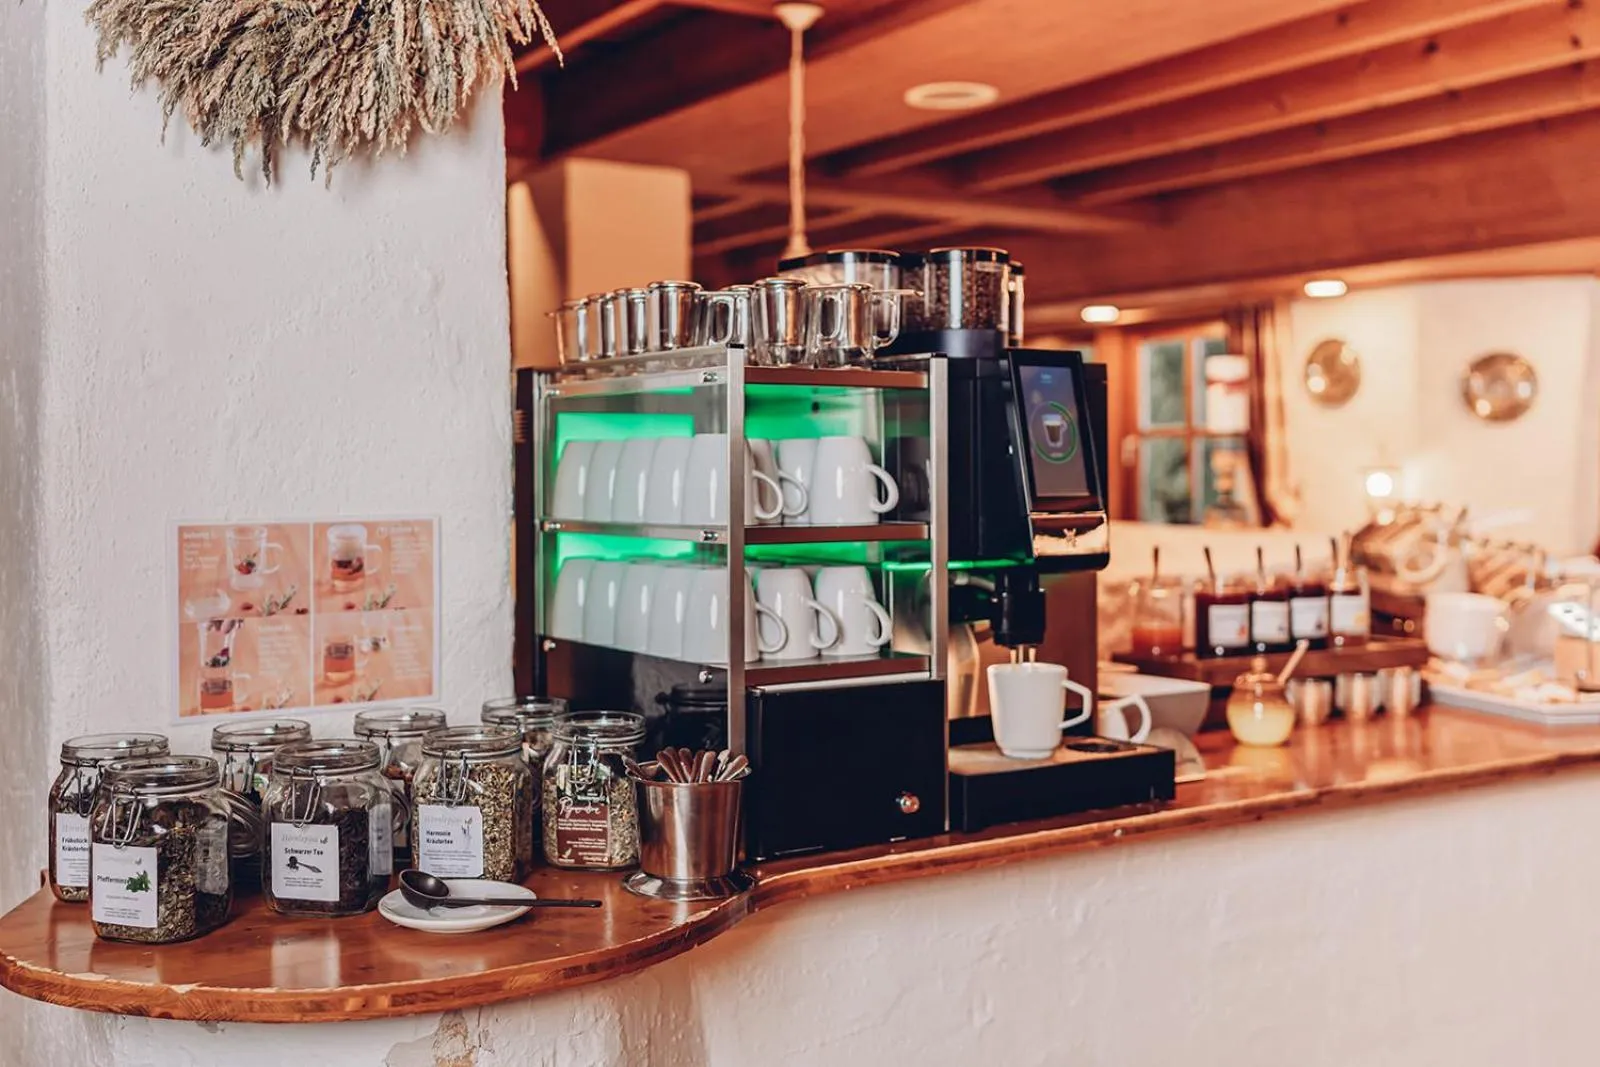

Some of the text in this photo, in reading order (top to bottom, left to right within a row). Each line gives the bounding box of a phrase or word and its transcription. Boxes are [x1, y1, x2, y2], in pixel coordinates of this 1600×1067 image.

[426, 837, 453, 845] Kräutertee
[284, 847, 324, 856] Schwarzer Tee
